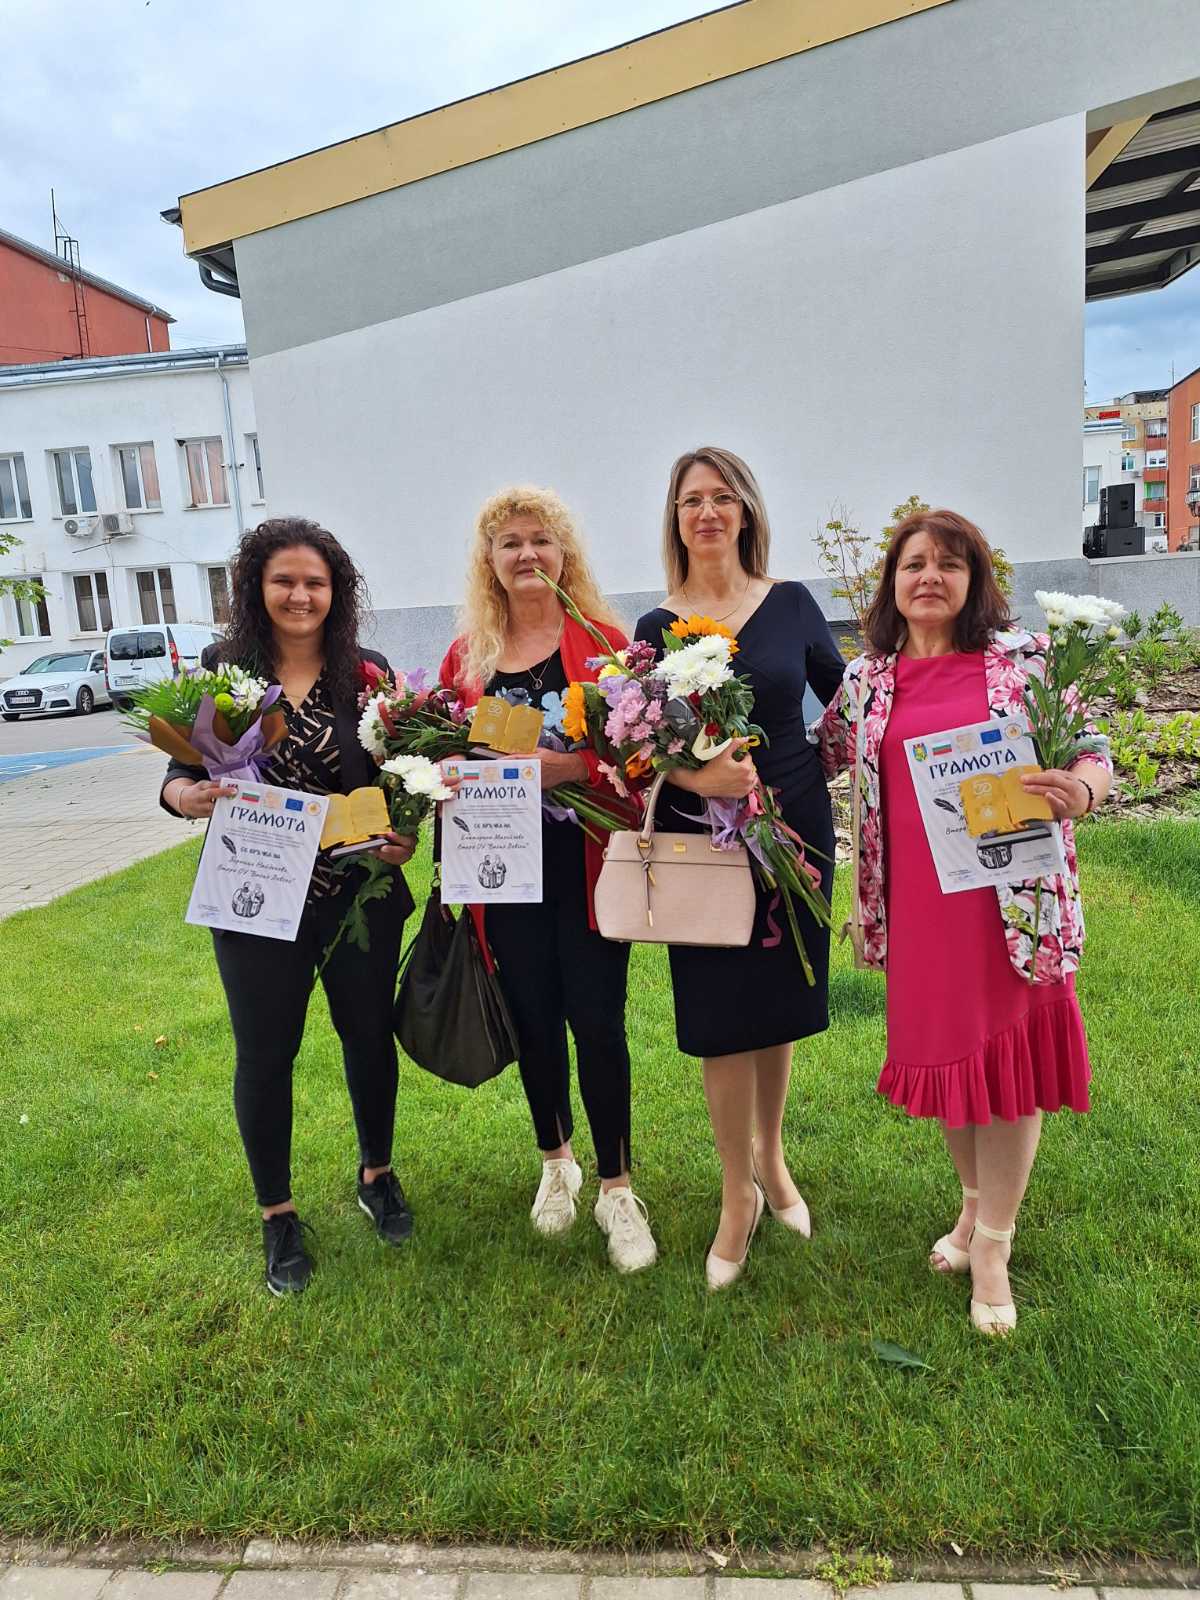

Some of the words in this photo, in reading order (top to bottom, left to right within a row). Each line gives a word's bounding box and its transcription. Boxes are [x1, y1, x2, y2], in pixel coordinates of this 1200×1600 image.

[928, 748, 1017, 779] ГРАМОТА
[456, 786, 526, 800] ГРАМОТА
[230, 805, 306, 833] ГРАМОТА
